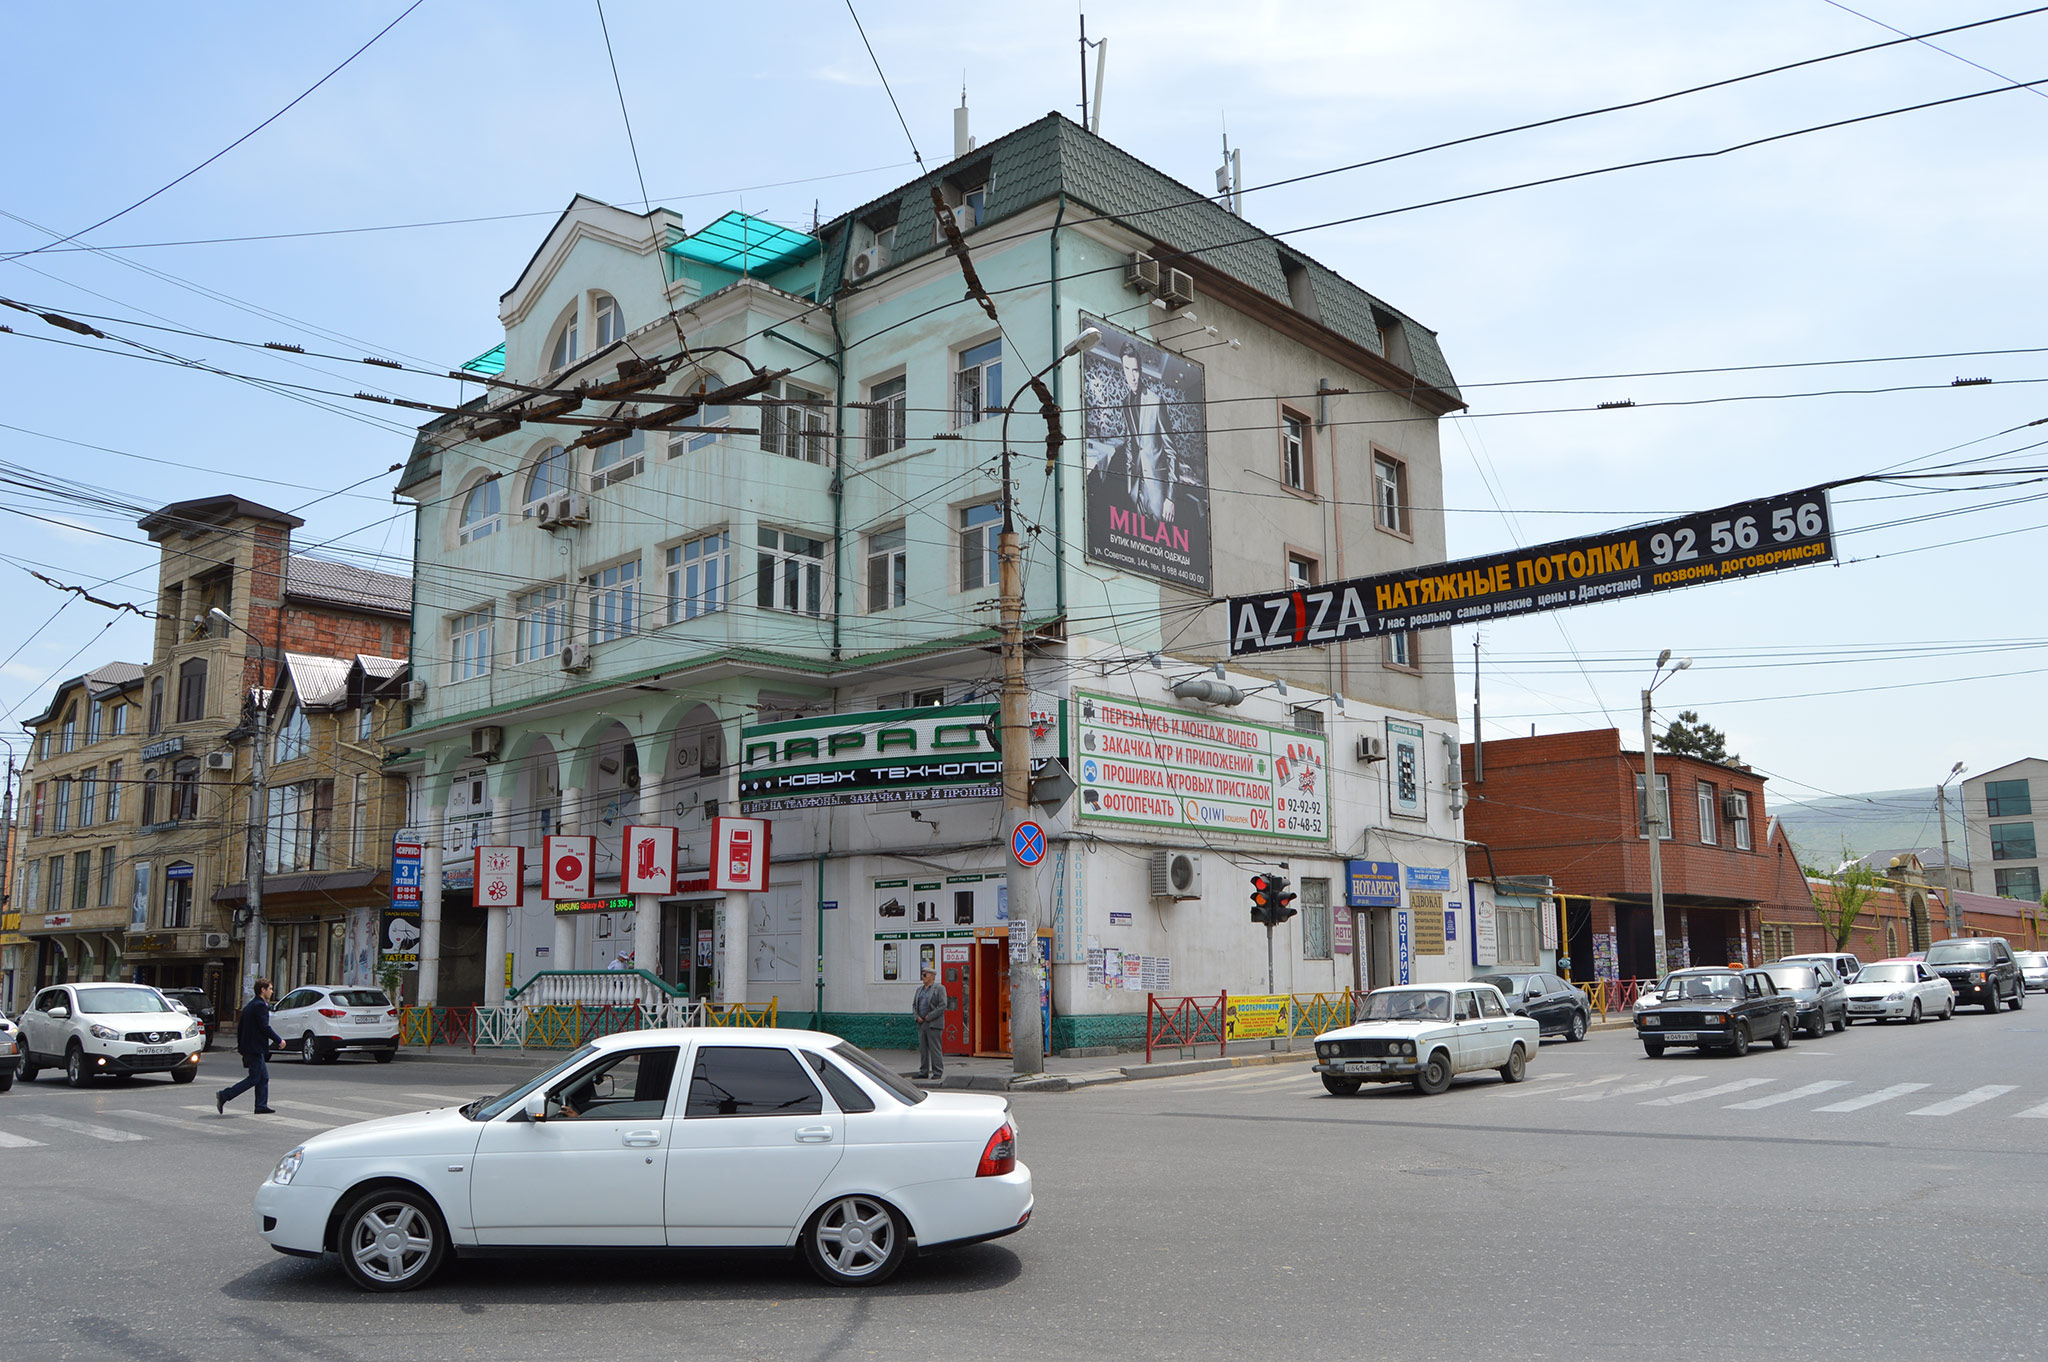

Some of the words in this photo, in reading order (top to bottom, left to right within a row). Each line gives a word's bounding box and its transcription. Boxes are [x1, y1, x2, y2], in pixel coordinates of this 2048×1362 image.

[1110, 505, 1189, 552] MILAN
[1110, 534, 1129, 548] БУТИК
[1130, 540, 1163, 557] МУЖСКОЙ
[1164, 550, 1190, 565] ОДЕЖДЫ
[1376, 563, 1511, 611] НАТЯЖНЫЕ
[1517, 540, 1640, 588] ПОТОЛКИ
[1651, 528, 1698, 565] 92
[1710, 516, 1759, 554] 56
[1772, 502, 1823, 542] 56
[1721, 542, 1826, 575] ДОГОВОРИМСЯ!
[1378, 618, 1386, 630] У
[1387, 617, 1406, 628] нас
[1410, 609, 1452, 628] реально
[1457, 603, 1492, 618] самые
[1493, 598, 1532, 614] низкие
[1538, 590, 1567, 608] цены
[1569, 590, 1576, 600] в
[1578, 575, 1642, 601] Дагестане!
[1234, 587, 1371, 650] AZIZA
[1102, 706, 1169, 733] ПЕРЕЗАПИСЬ
[1171, 720, 1179, 734] И
[1181, 721, 1226, 742] МОНТАЖ
[1228, 731, 1258, 749] ВИДЕО
[746, 724, 980, 765] ПАРАД
[1102, 735, 1152, 758] ЗАКАЧКА
[1154, 744, 1174, 761] ИГР
[1176, 748, 1184, 763] И
[1186, 749, 1254, 773] ПРИЛОЖЕНИЙ
[778, 770, 855, 787] НОВЫХ
[1103, 764, 1164, 788] ПРОШИВКА
[1166, 774, 1214, 794] ИГРОВЫХ
[1216, 780, 1270, 802] ПРИСТАВОК
[752, 804, 768, 812] ИГР
[770, 802, 784, 811] НА
[850, 792, 902, 804] ЗАКАЧКА
[905, 790, 928, 800] ИГР
[931, 790, 940, 799] И
[943, 786, 1002, 798] ПРОШИВ
[1103, 793, 1174, 816] ФОТОПЕЧАТЬ
[1288, 798, 1321, 815] 92-92-92
[1201, 806, 1225, 824] QIWI
[1250, 808, 1270, 831] 0%
[1288, 816, 1322, 832] 67-48-52
[402, 866, 408, 877] 3
[1352, 880, 1400, 896] НОТАРИУС
[555, 902, 580, 912] SAMSUNG
[580, 901, 597, 910] Galaxy
[598, 900, 605, 909] A3
[610, 900, 616, 908] 16
[618, 899, 628, 908] 350
[1075, 853, 1084, 960] КОНДИЦИОНЕРЫ
[1412, 896, 1442, 908] АДВОКАТ
[1336, 927, 1352, 938] АВТО
